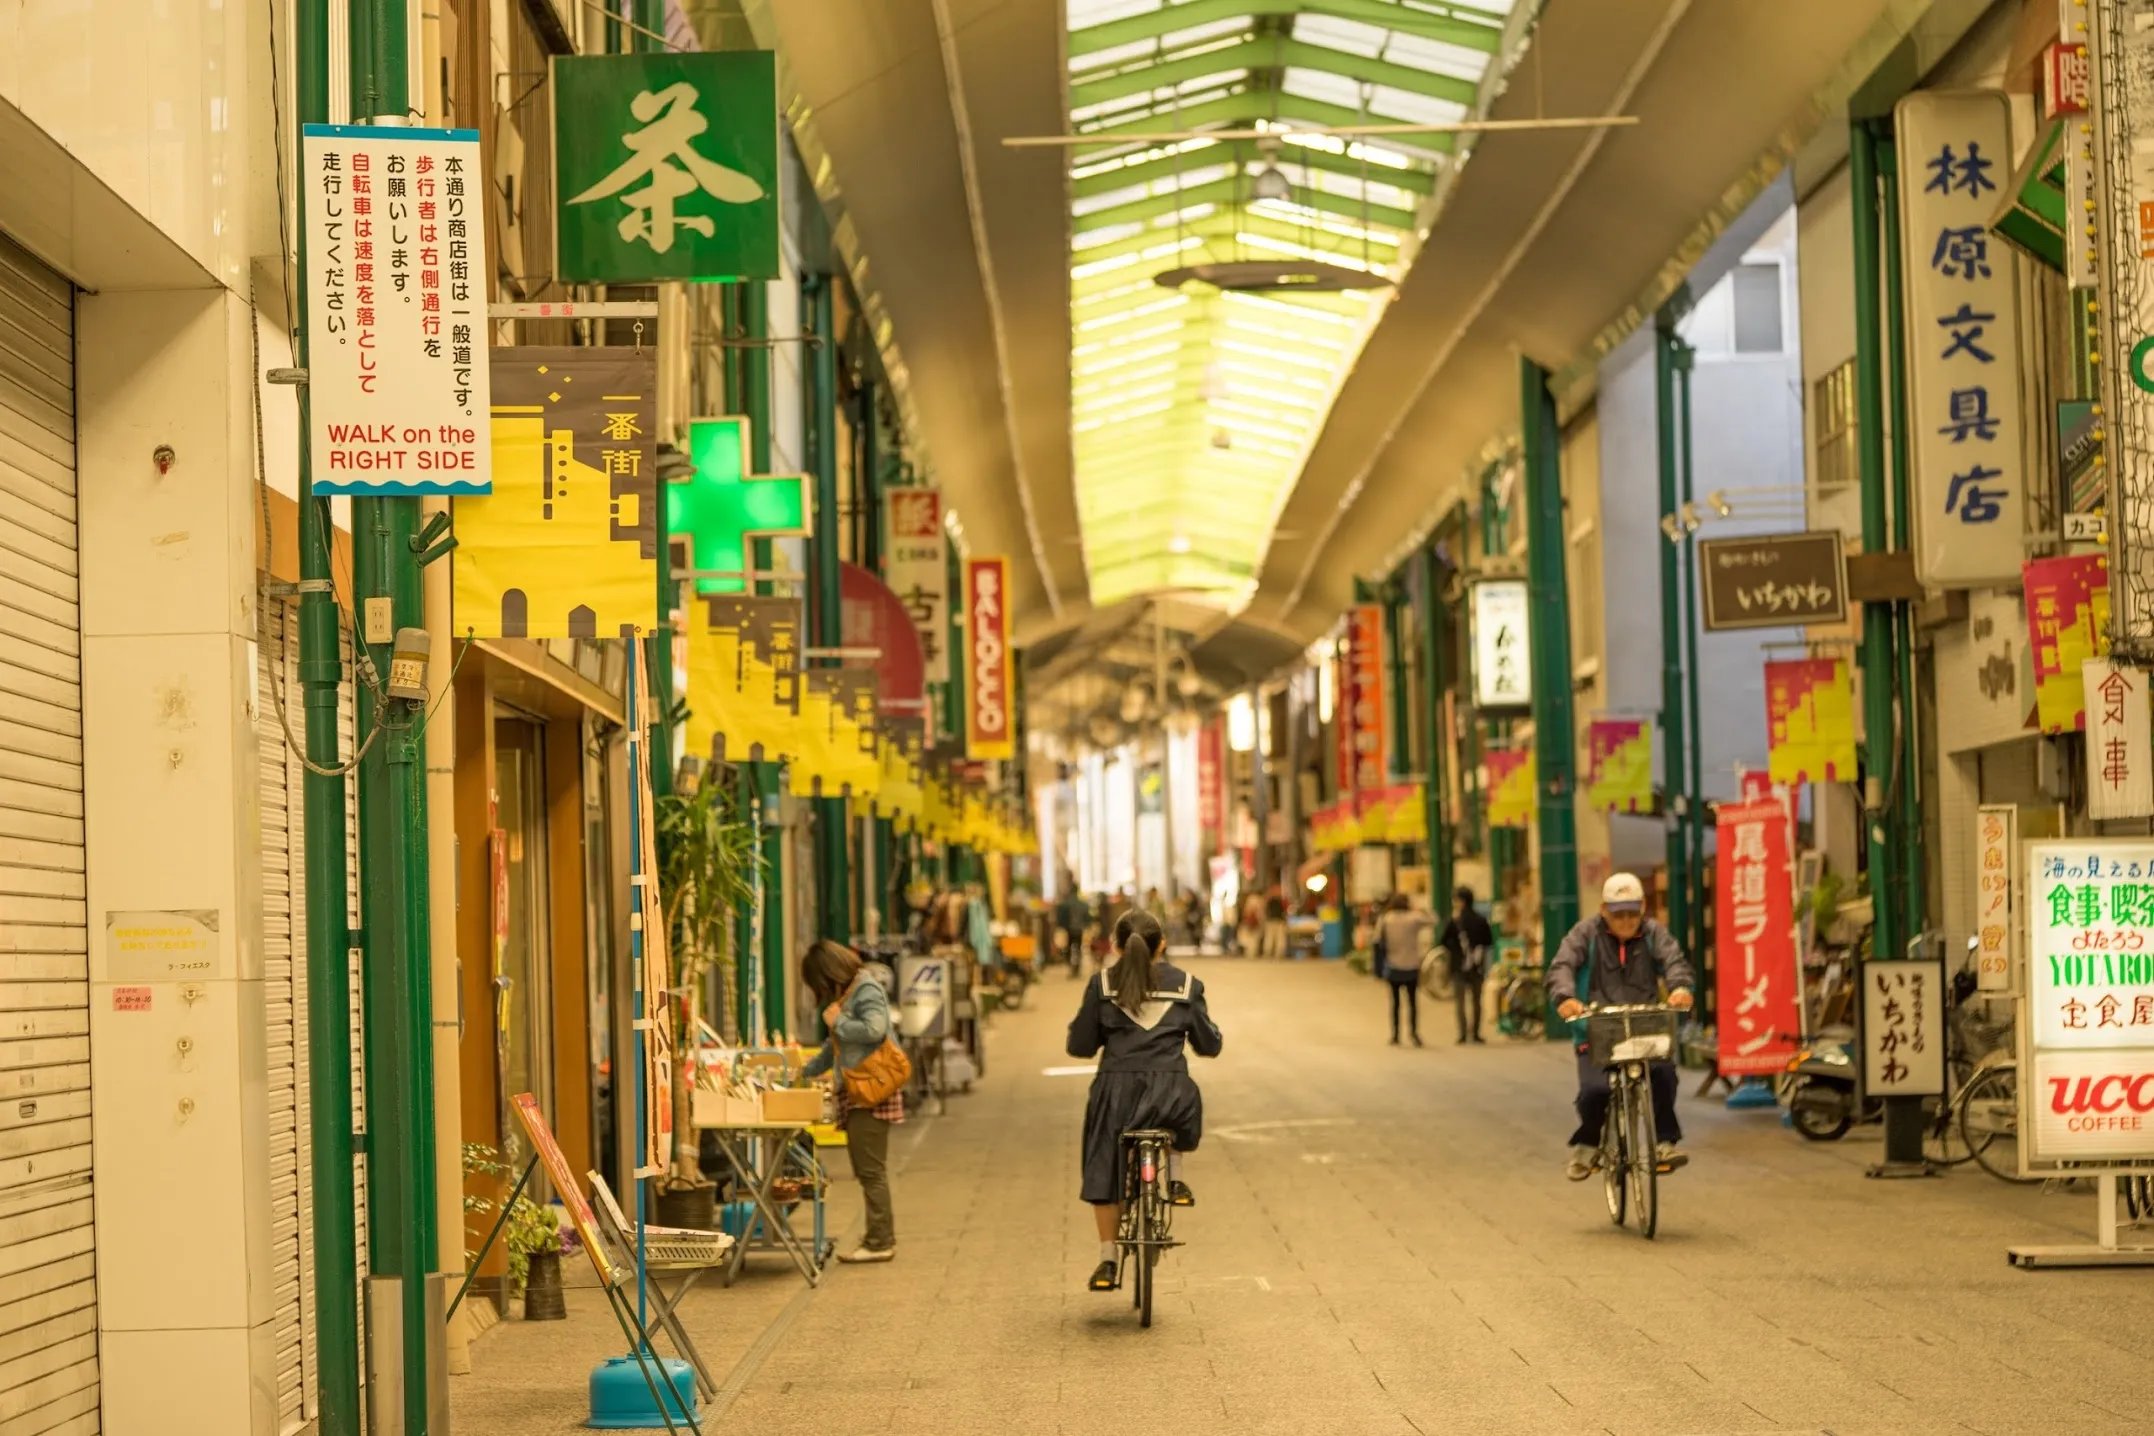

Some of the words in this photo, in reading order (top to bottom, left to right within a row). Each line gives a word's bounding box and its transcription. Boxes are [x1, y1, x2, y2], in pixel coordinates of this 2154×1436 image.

[386, 154, 411, 305] お願いします。
[565, 82, 766, 253] 茶
[322, 152, 347, 346] 走行してください。
[352, 152, 377, 394] 自転車は速度を落として
[416, 155, 442, 359] 歩行者は右側通行を
[445, 156, 473, 418] 本通り商店街は一般道です。
[1924, 142, 2009, 524] 林原文具店
[328, 424, 396, 443] WALK
[403, 430, 432, 443] on
[439, 424, 475, 443] the
[330, 451, 407, 469] RIGHT
[417, 451, 475, 469] SIDE
[601, 395, 643, 477] 一番街
[1732, 822, 1776, 1055] 尾道ラーメン
[2049, 953, 2154, 987] YOTARO
[2072, 930, 2144, 950] よたろう
[1876, 973, 1908, 1085] いちかわ
[2068, 1117, 2142, 1132] COFFEE
